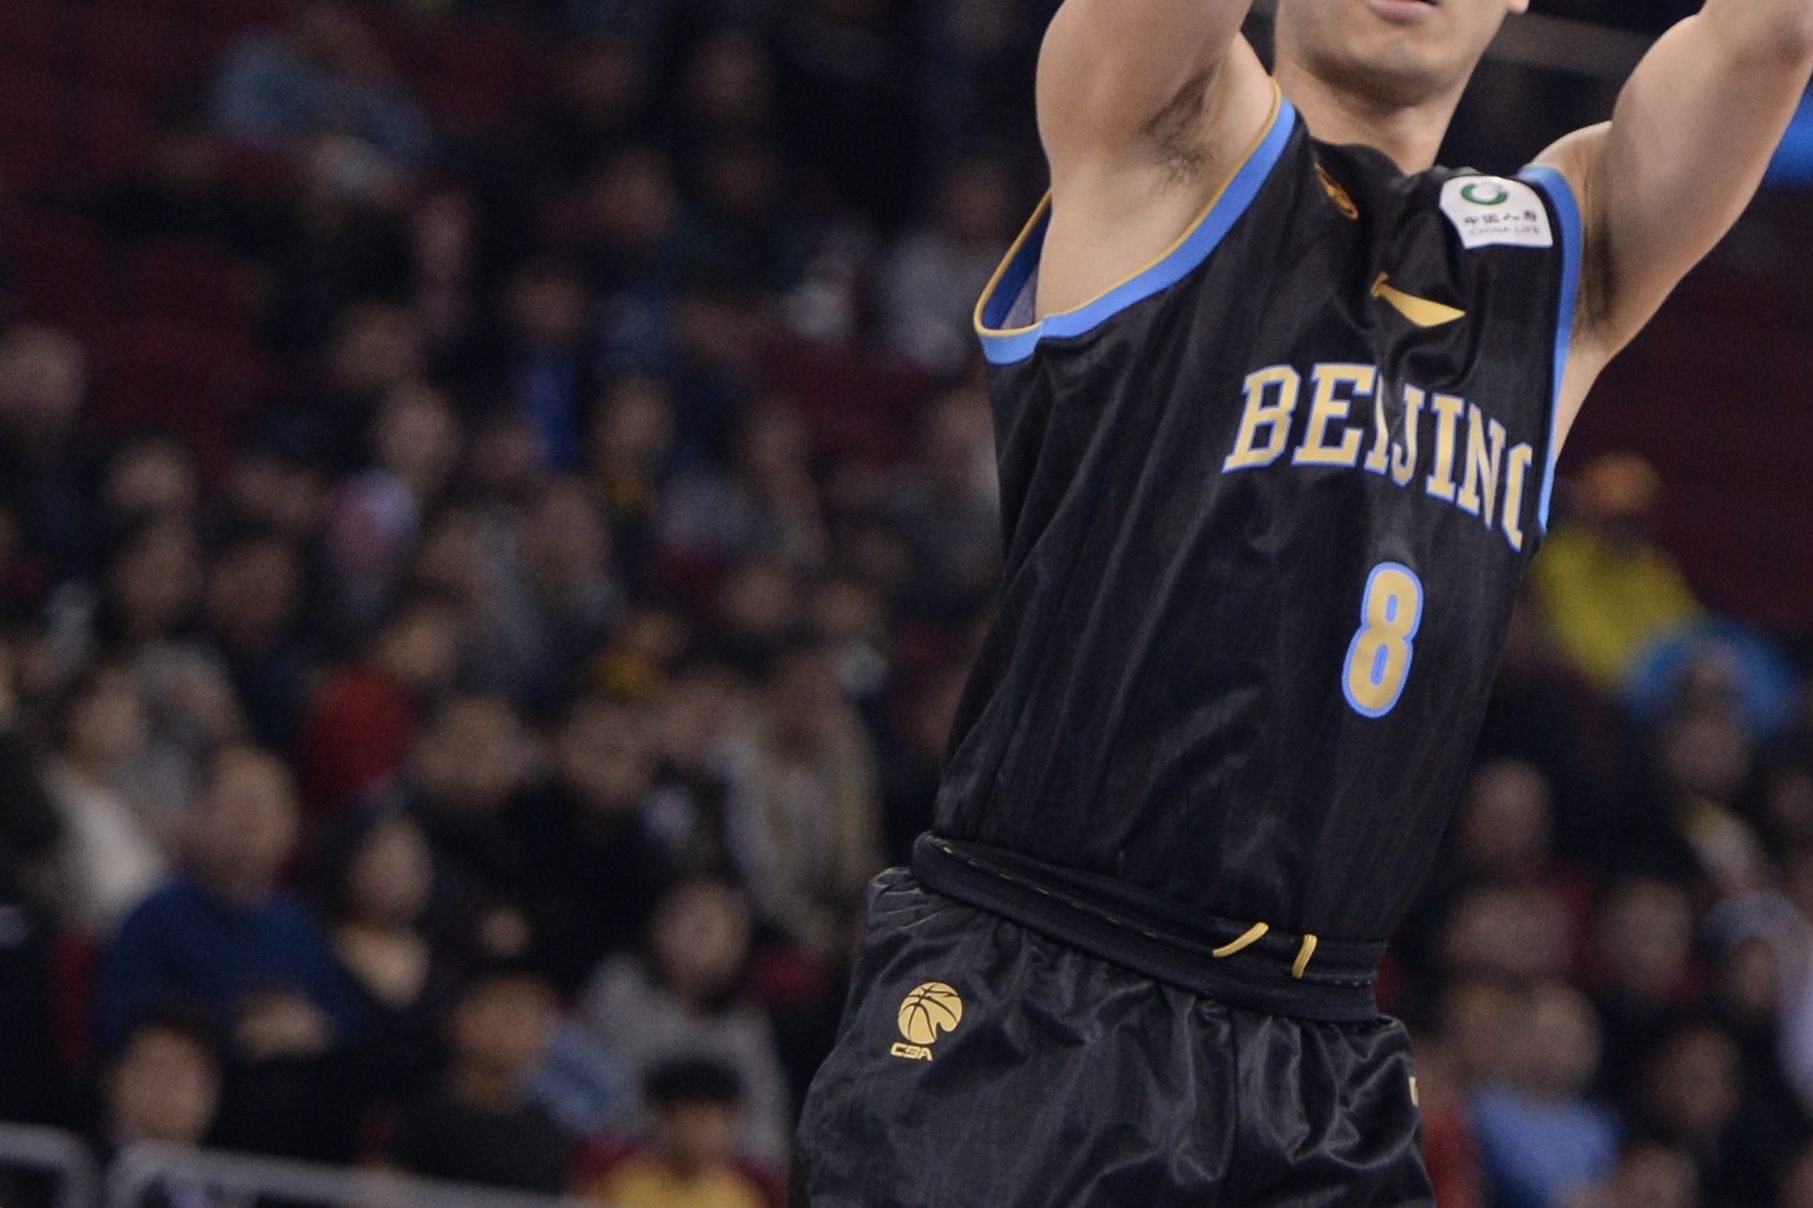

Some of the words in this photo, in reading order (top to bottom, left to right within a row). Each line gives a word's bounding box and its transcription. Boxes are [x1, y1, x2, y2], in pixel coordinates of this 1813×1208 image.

[1514, 224, 1540, 235] LIFE
[1341, 561, 1424, 718] 8
[890, 1042, 933, 1061] CBA
